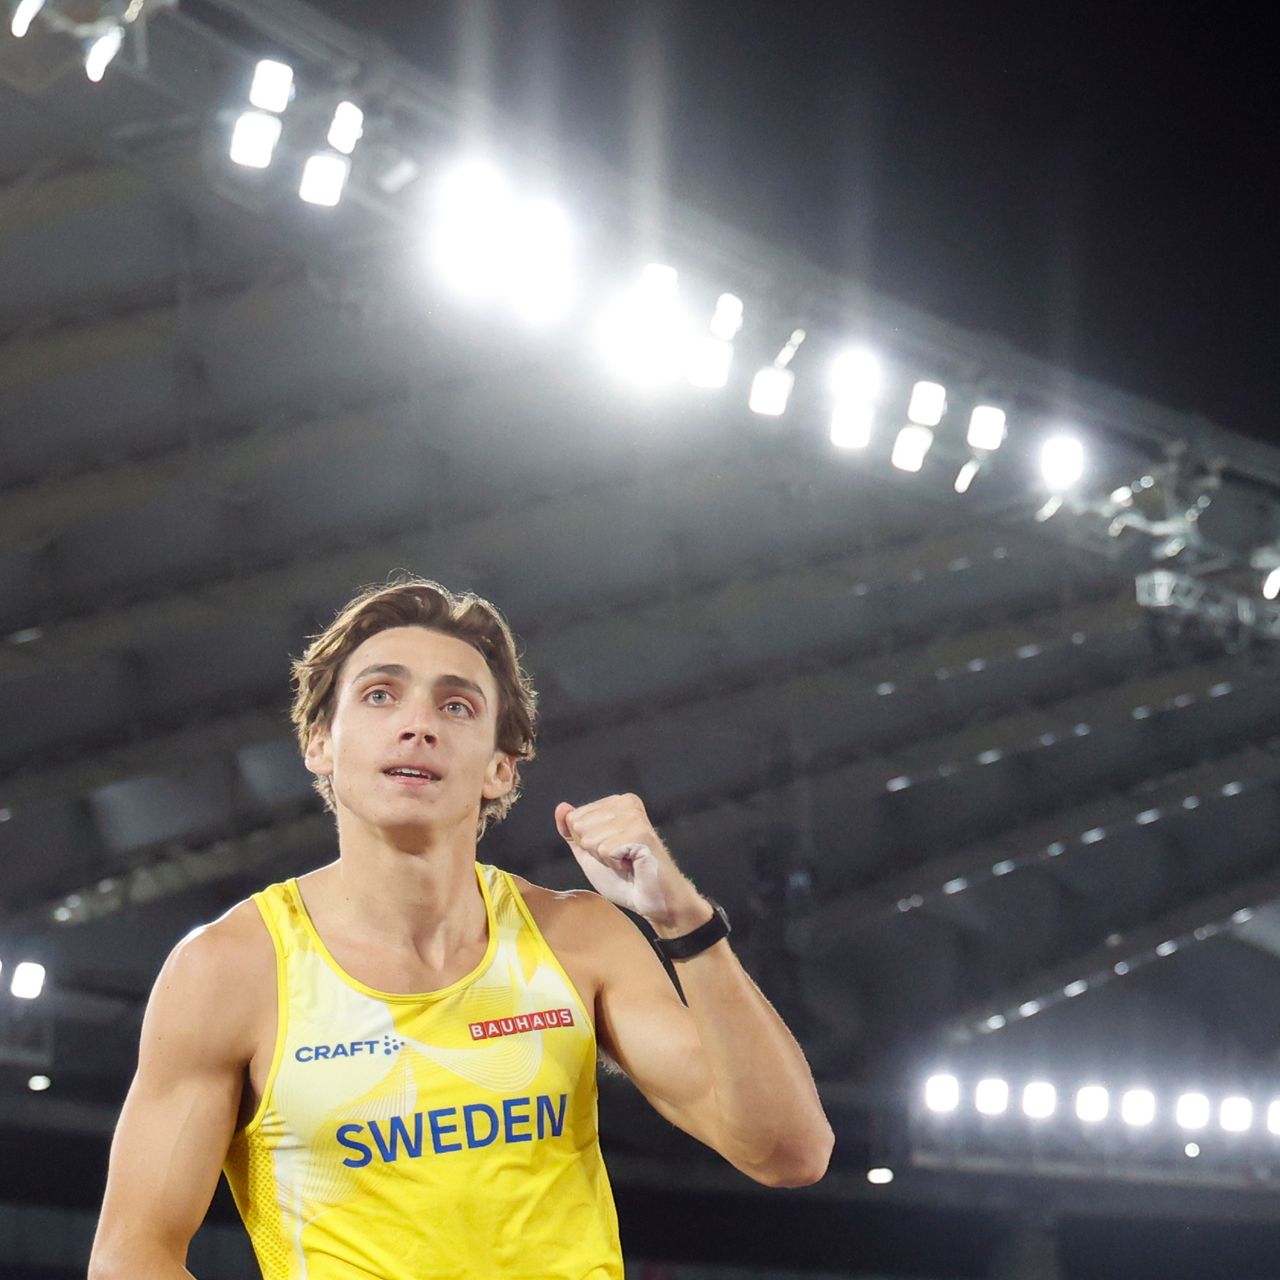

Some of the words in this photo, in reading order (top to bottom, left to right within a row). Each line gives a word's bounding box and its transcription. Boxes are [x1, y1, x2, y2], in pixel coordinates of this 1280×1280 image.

[471, 1009, 572, 1039] BAUHAUS
[295, 1040, 380, 1062] CRAFT
[336, 1094, 567, 1168] SWEDEN
